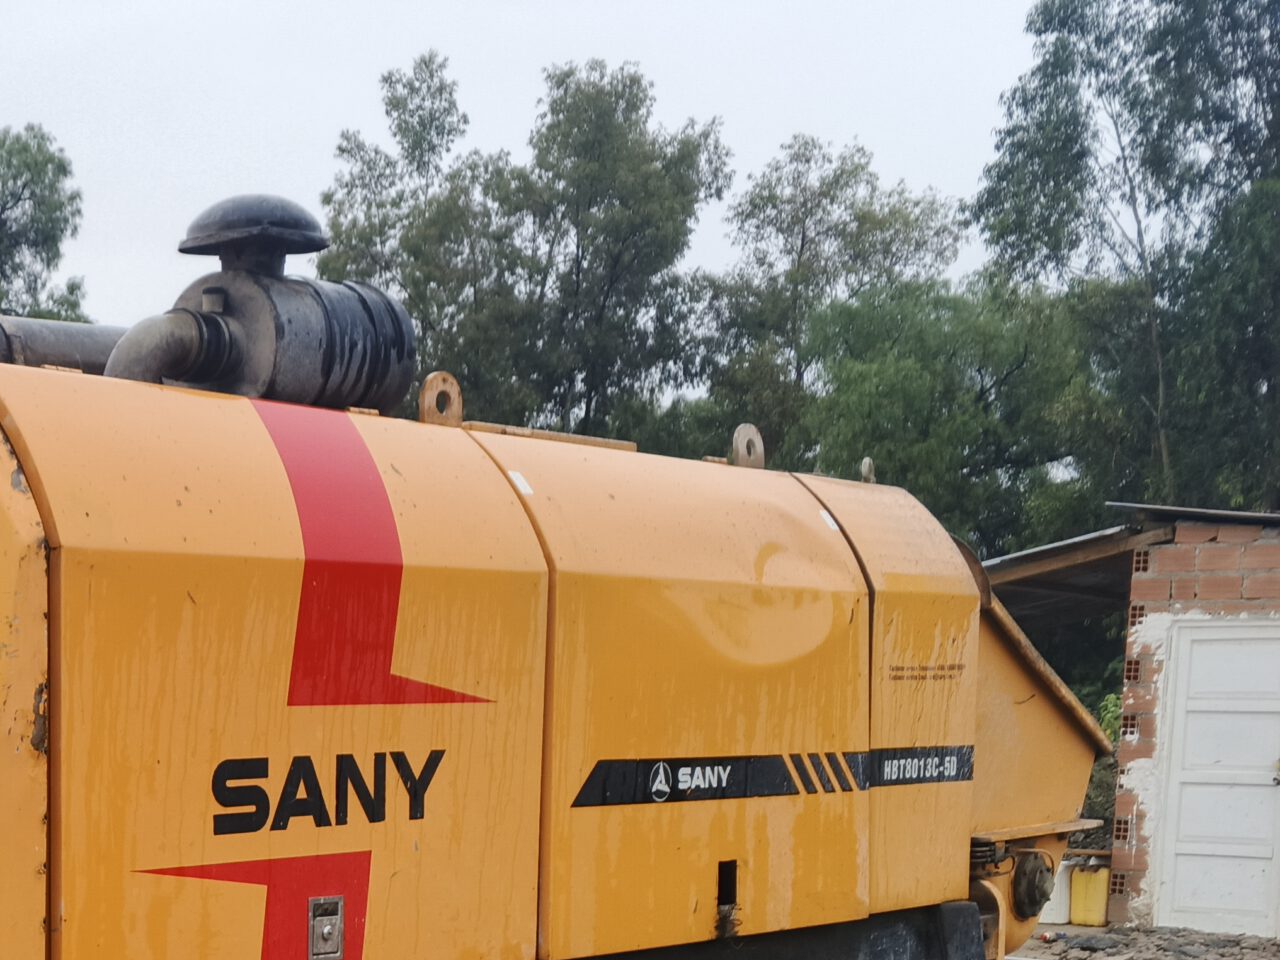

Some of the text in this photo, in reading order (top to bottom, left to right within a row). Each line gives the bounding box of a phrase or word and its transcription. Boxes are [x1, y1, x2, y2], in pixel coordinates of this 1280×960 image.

[678, 765, 731, 790] SANY
[884, 756, 958, 780] HBT8013C-5D
[211, 749, 446, 835] SANY
